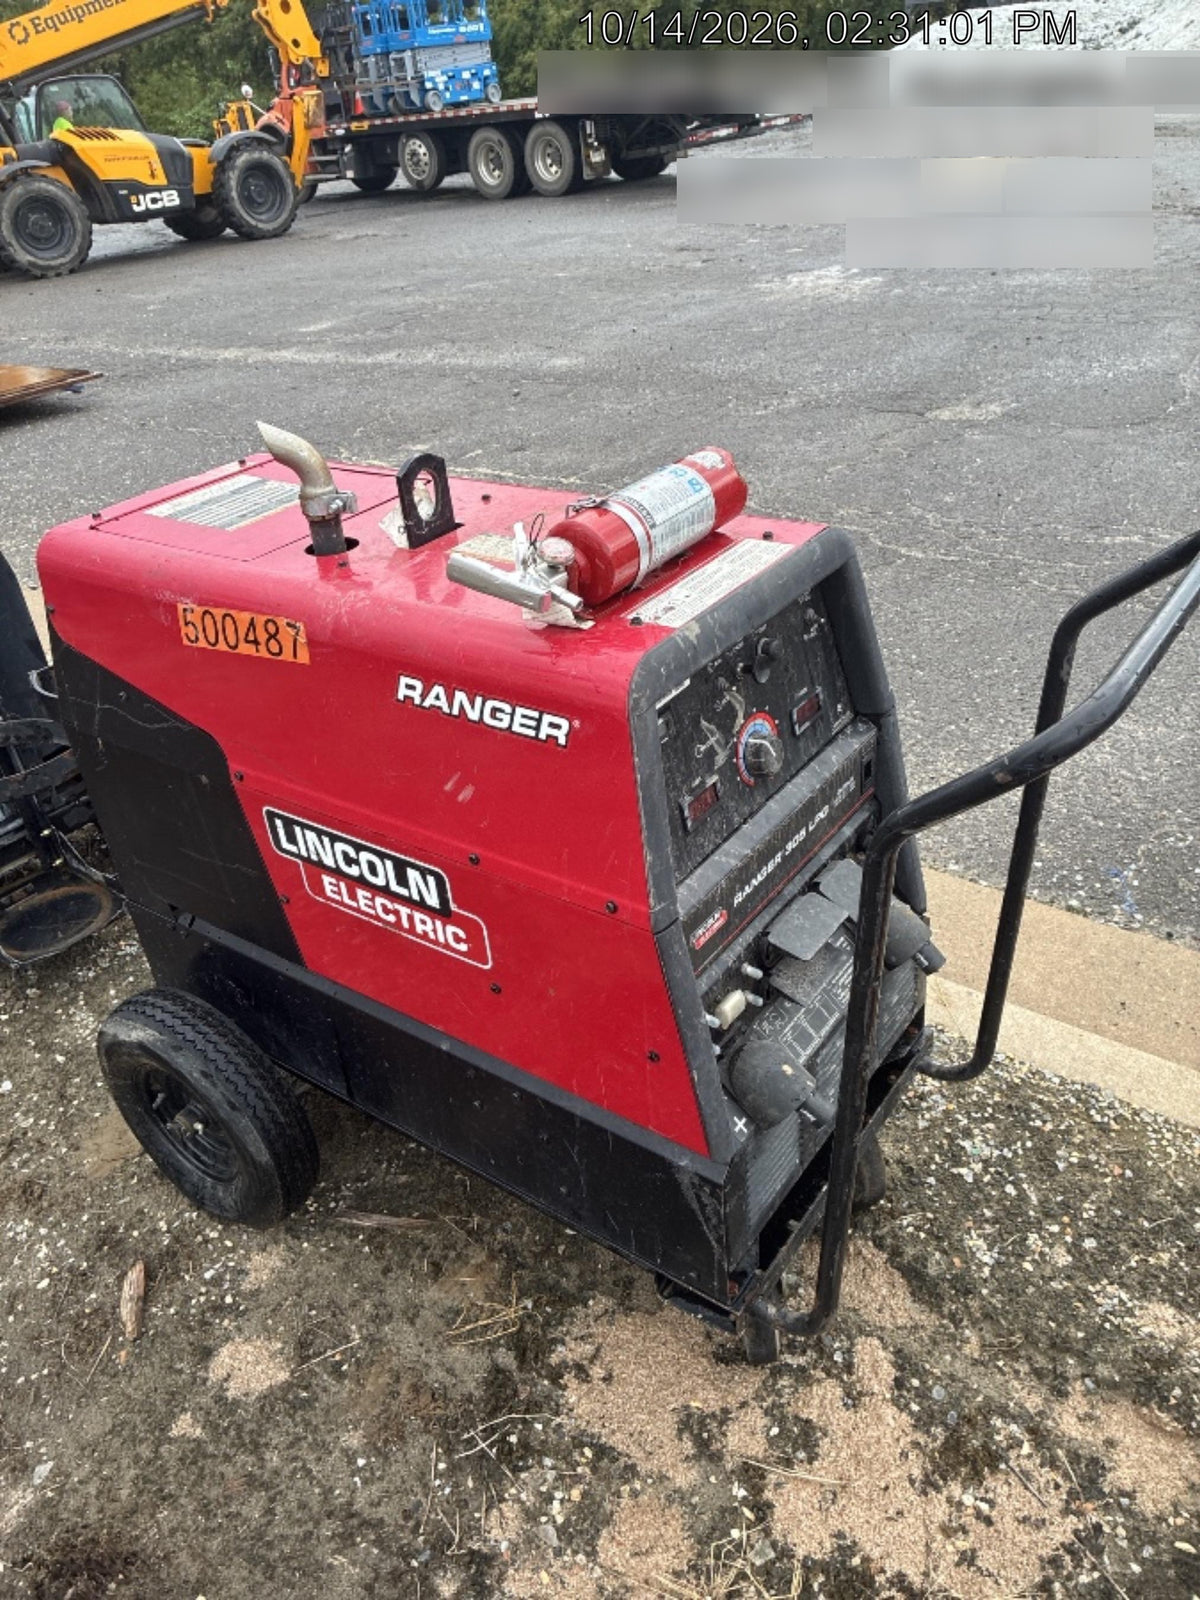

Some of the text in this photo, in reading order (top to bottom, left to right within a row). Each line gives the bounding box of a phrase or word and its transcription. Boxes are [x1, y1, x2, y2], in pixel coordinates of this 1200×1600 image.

[132, 190, 180, 213] JCB
[182, 607, 300, 660] 500487
[274, 817, 441, 910] LINCOLN
[733, 849, 783, 907] RANGER
[321, 873, 470, 952] ELECTRIC
